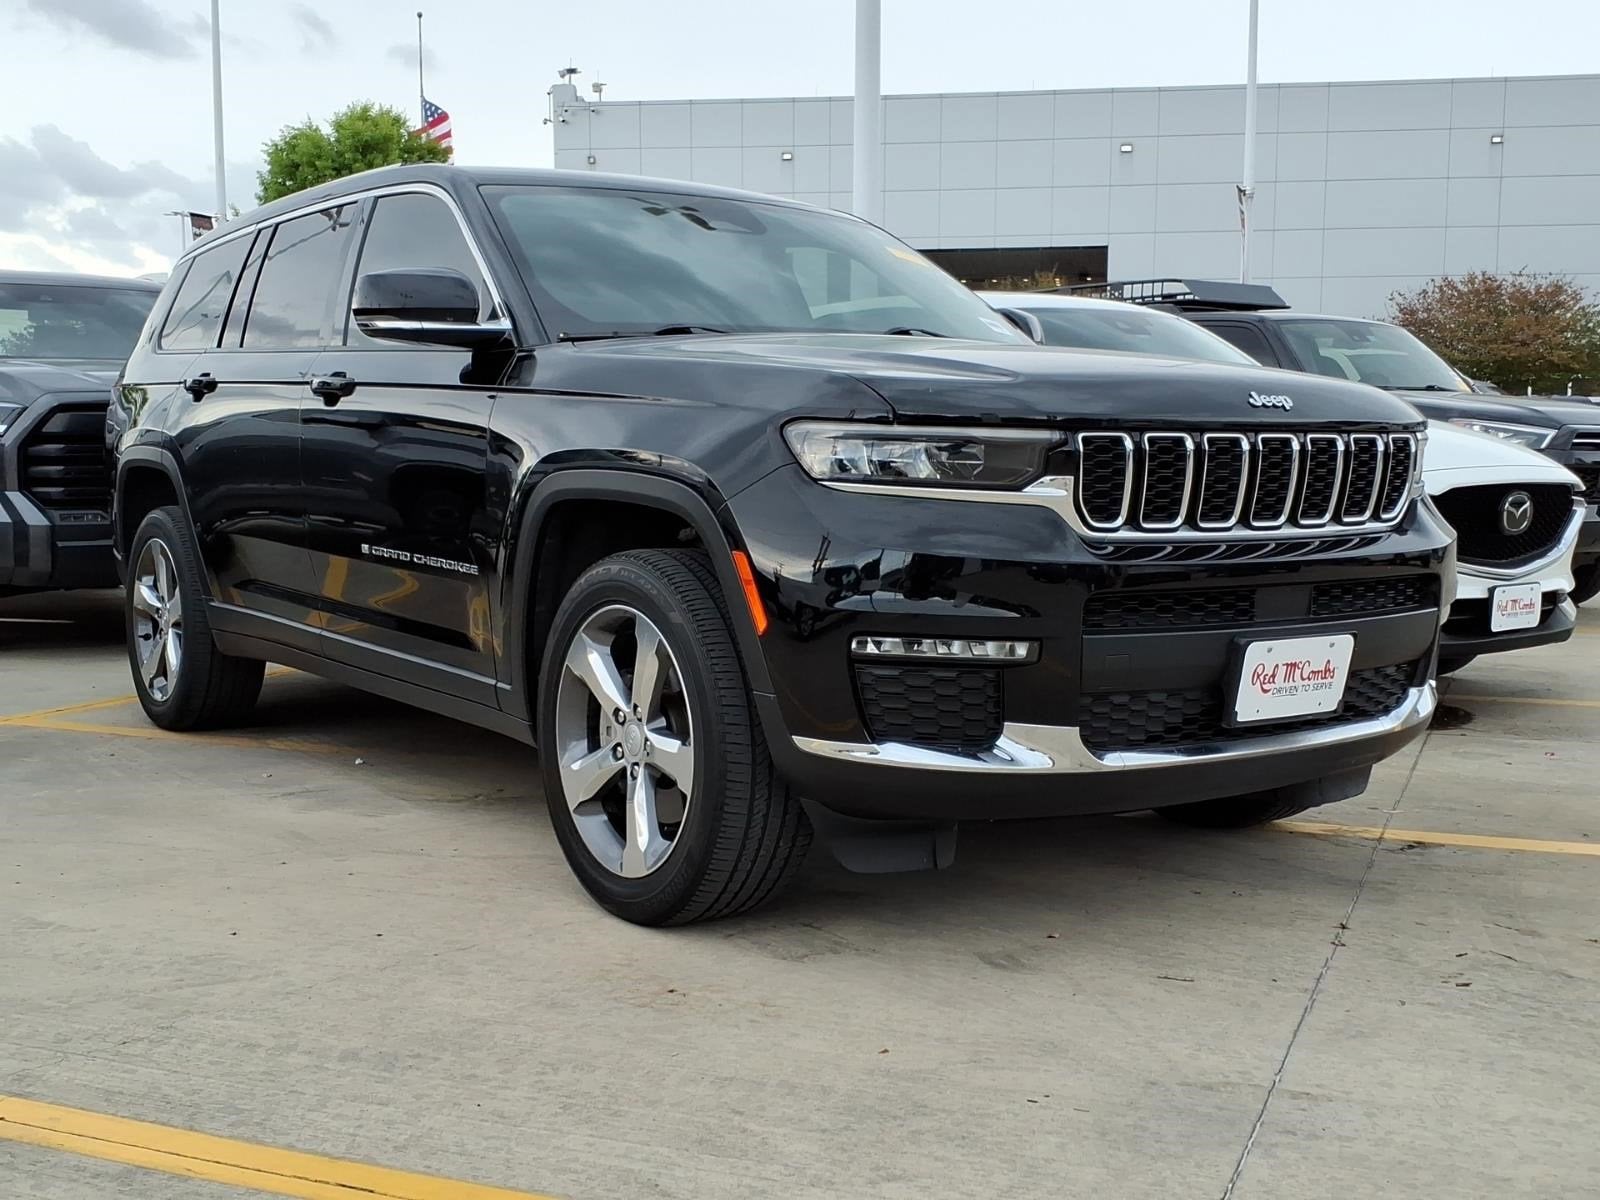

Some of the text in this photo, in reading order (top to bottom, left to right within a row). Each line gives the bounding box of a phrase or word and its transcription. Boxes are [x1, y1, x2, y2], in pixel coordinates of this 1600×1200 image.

[1248, 391, 1293, 411] Jeep
[372, 546, 479, 575] GRAND CHEROKEE
[1251, 659, 1336, 694] Red McCombs
[1271, 682, 1334, 696] DRIVEN TO SERVE
